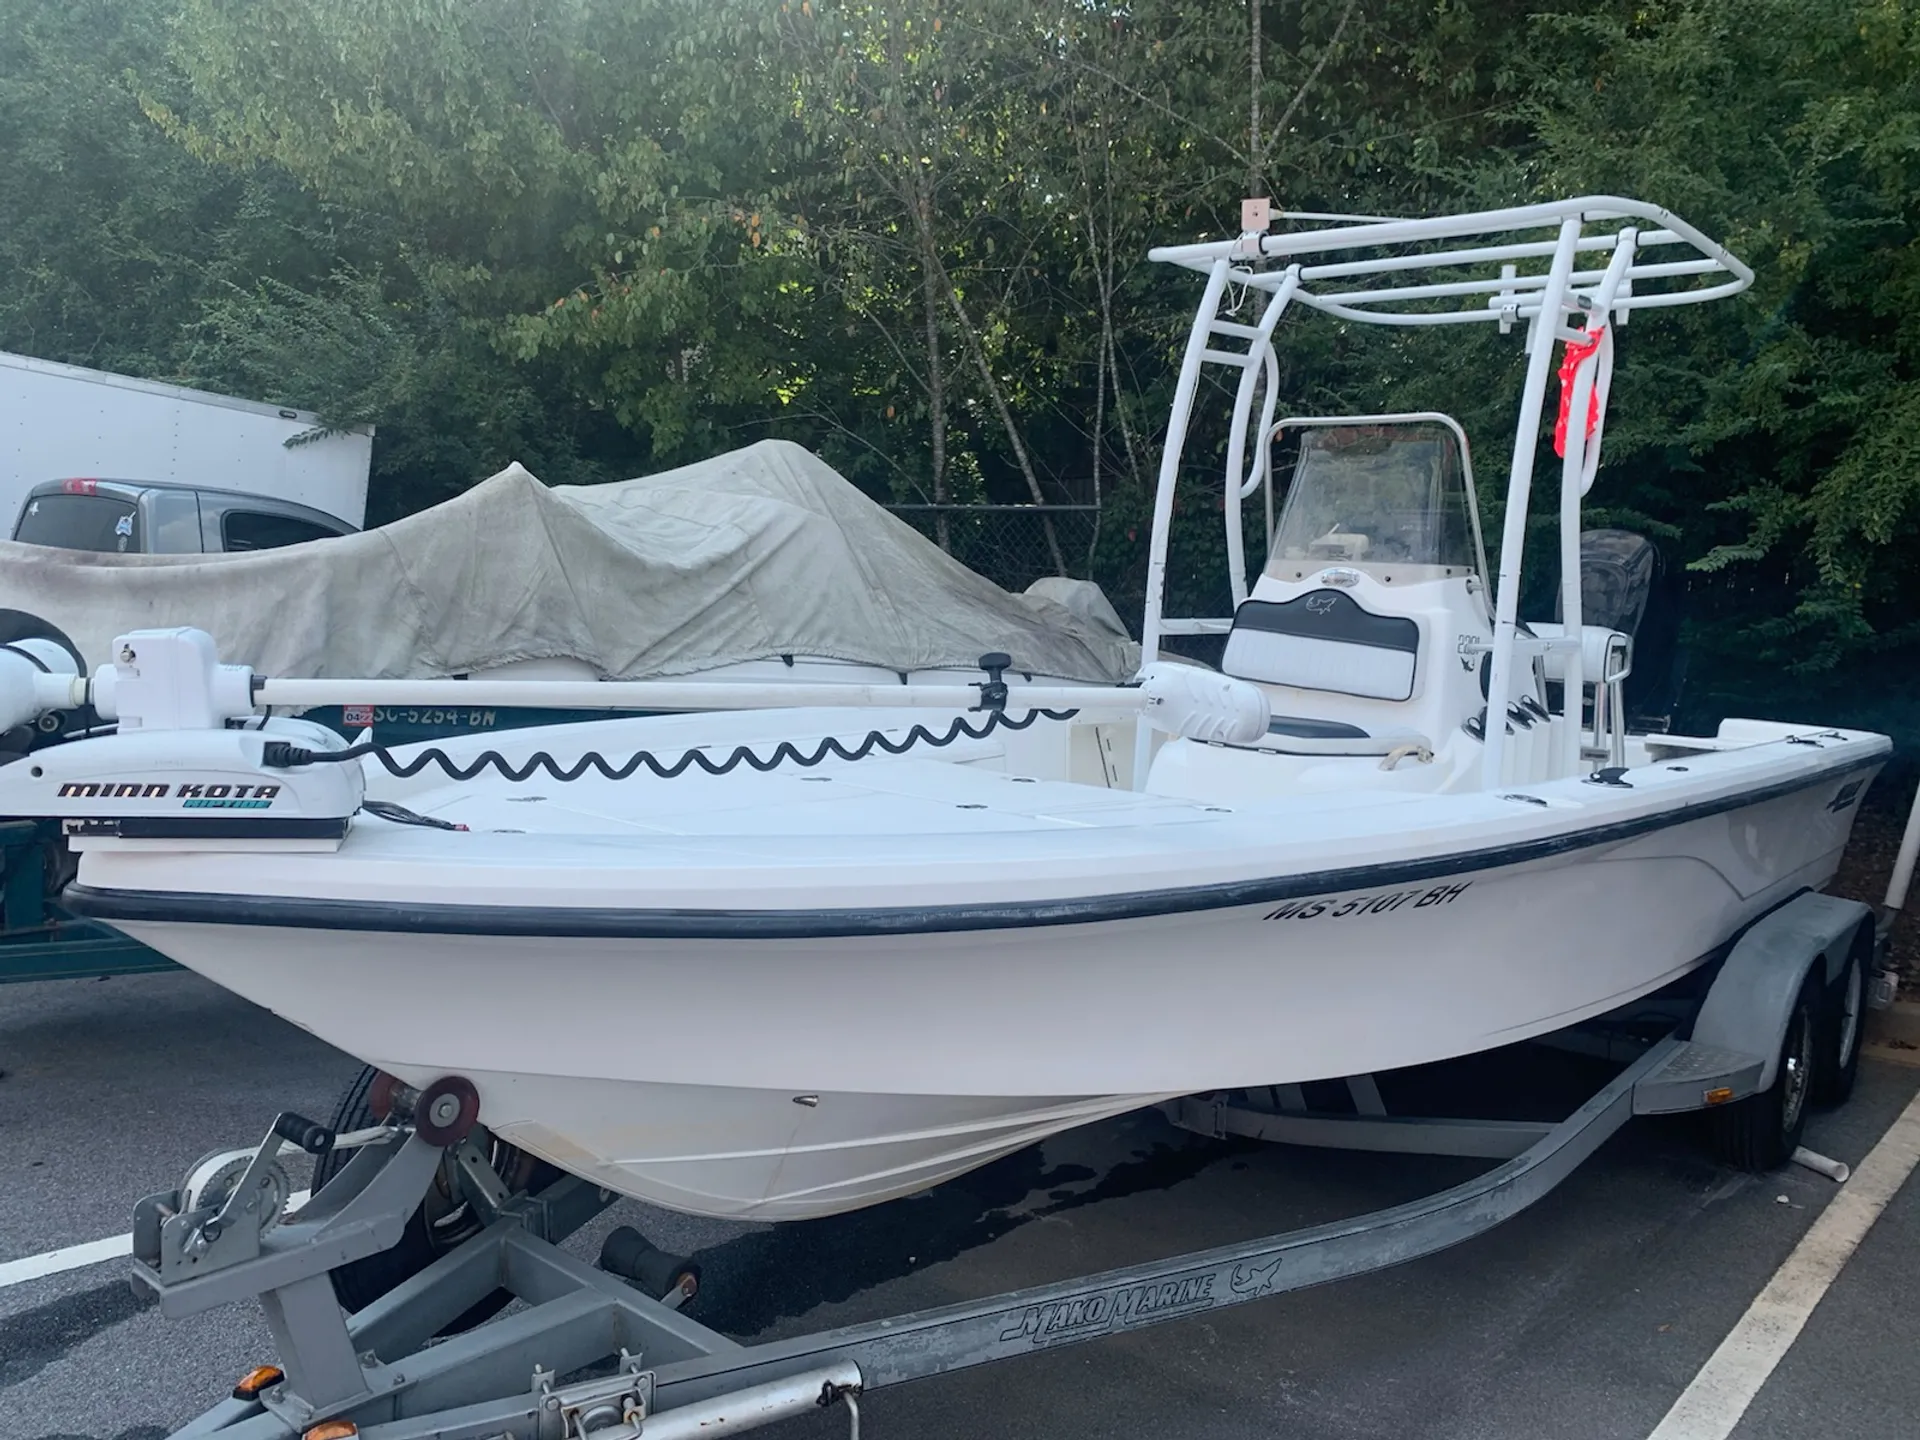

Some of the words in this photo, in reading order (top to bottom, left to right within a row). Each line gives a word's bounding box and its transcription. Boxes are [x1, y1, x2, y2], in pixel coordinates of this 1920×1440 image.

[177, 784, 281, 798] KOTA
[1263, 899, 1336, 921] MS
[1332, 889, 1424, 918] 5107
[1413, 881, 1475, 909] BH
[1000, 1296, 1110, 1344] MAKO
[1107, 1273, 1217, 1328] MARINE
